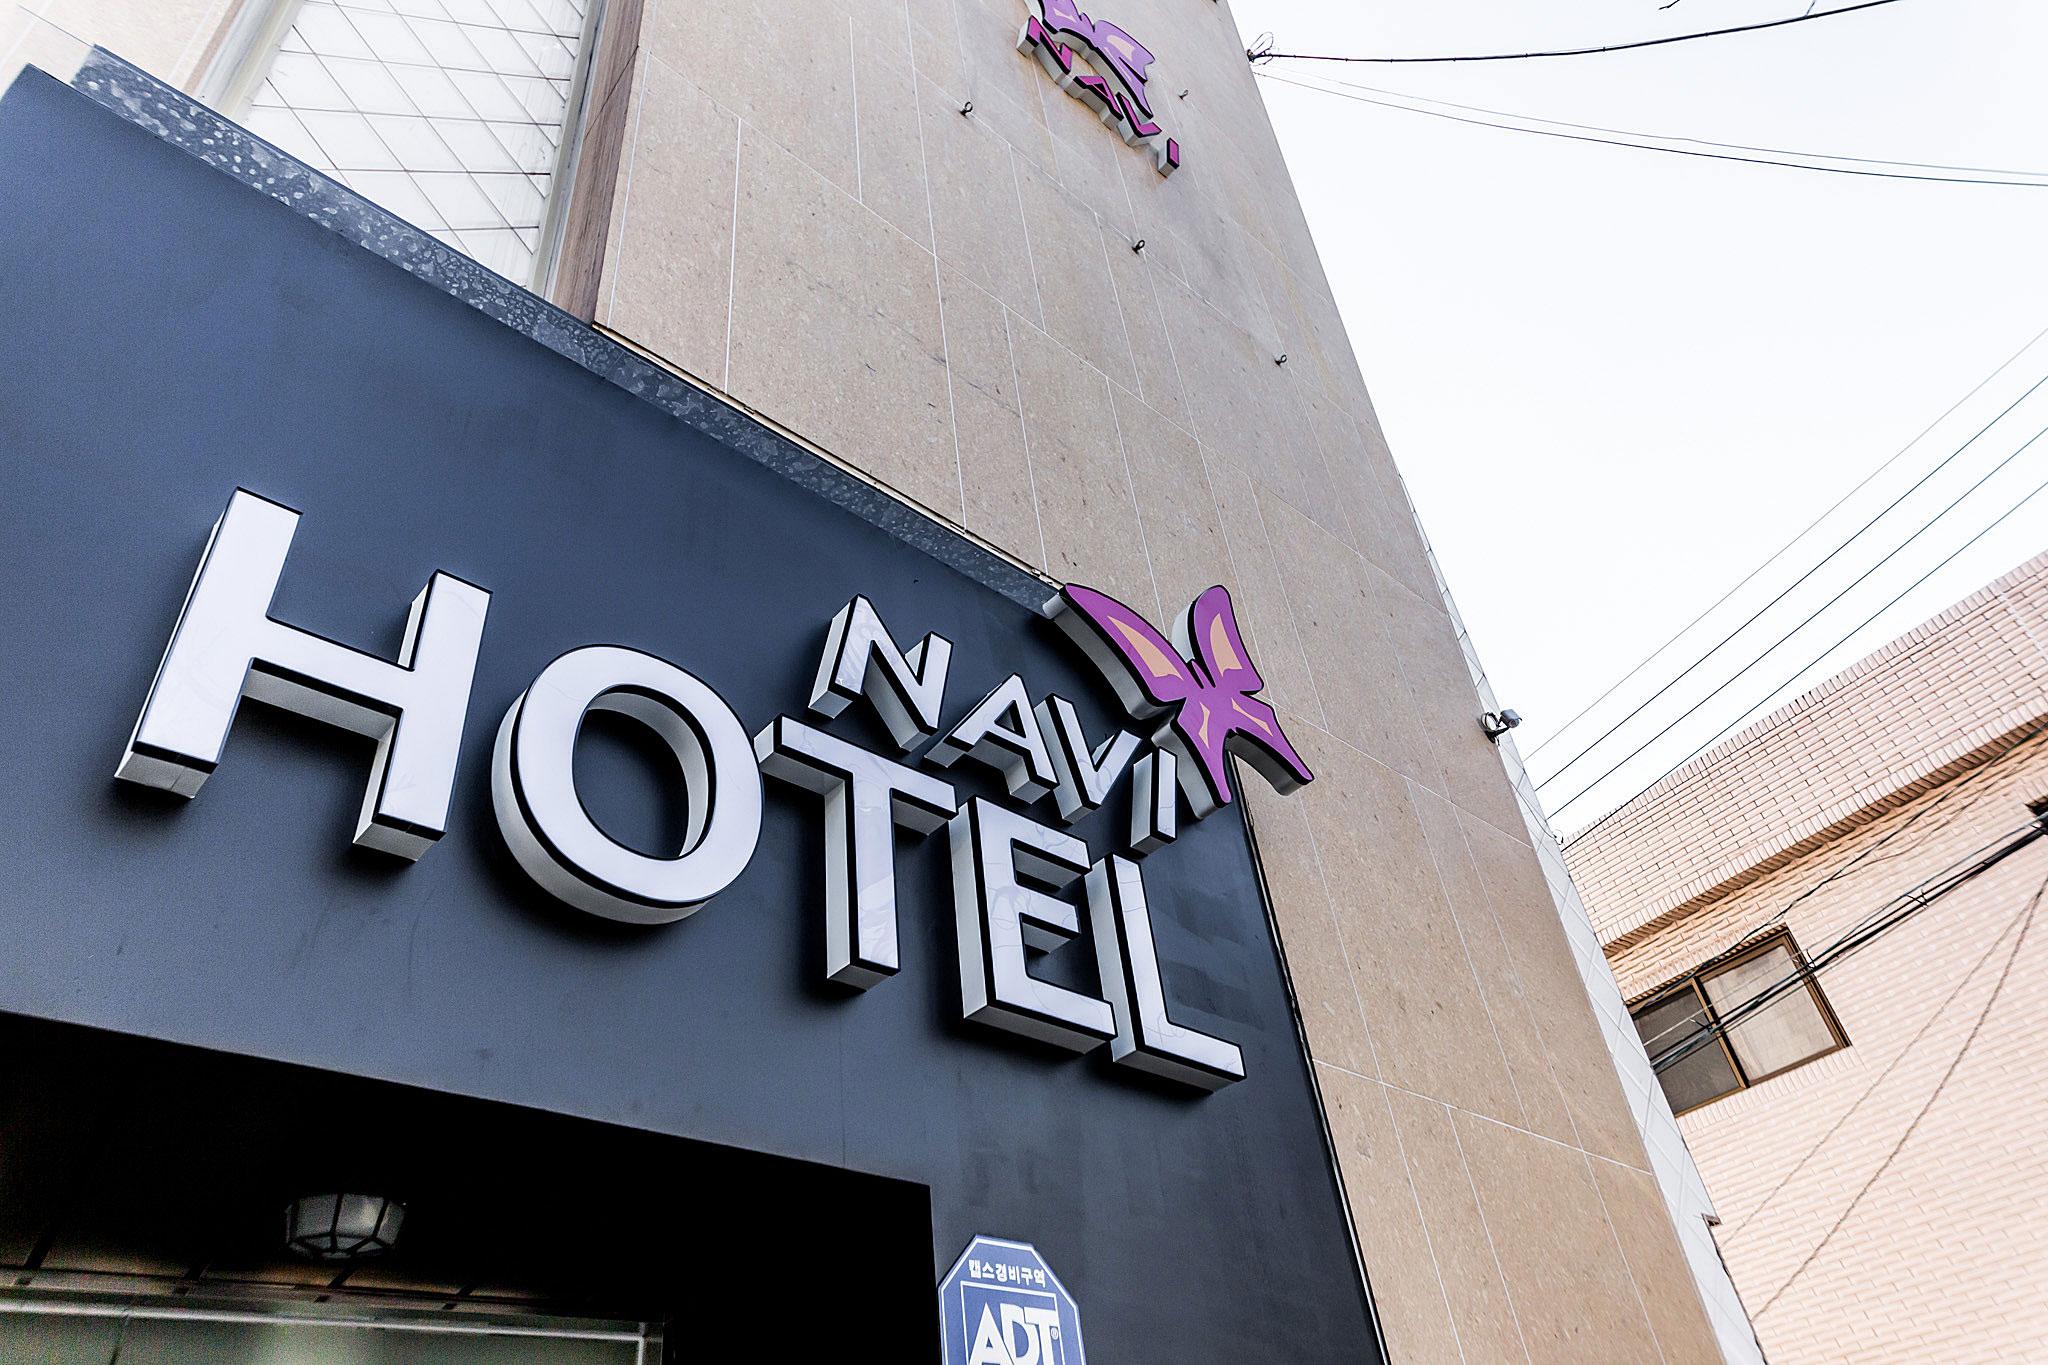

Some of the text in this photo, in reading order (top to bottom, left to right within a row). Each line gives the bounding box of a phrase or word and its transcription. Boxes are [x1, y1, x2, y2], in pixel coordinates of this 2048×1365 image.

[1021, 14, 1180, 170] NAVI
[128, 486, 1246, 1085] HOTEL
[822, 593, 1178, 845] NAVI
[968, 1302, 1059, 1365] ADT
